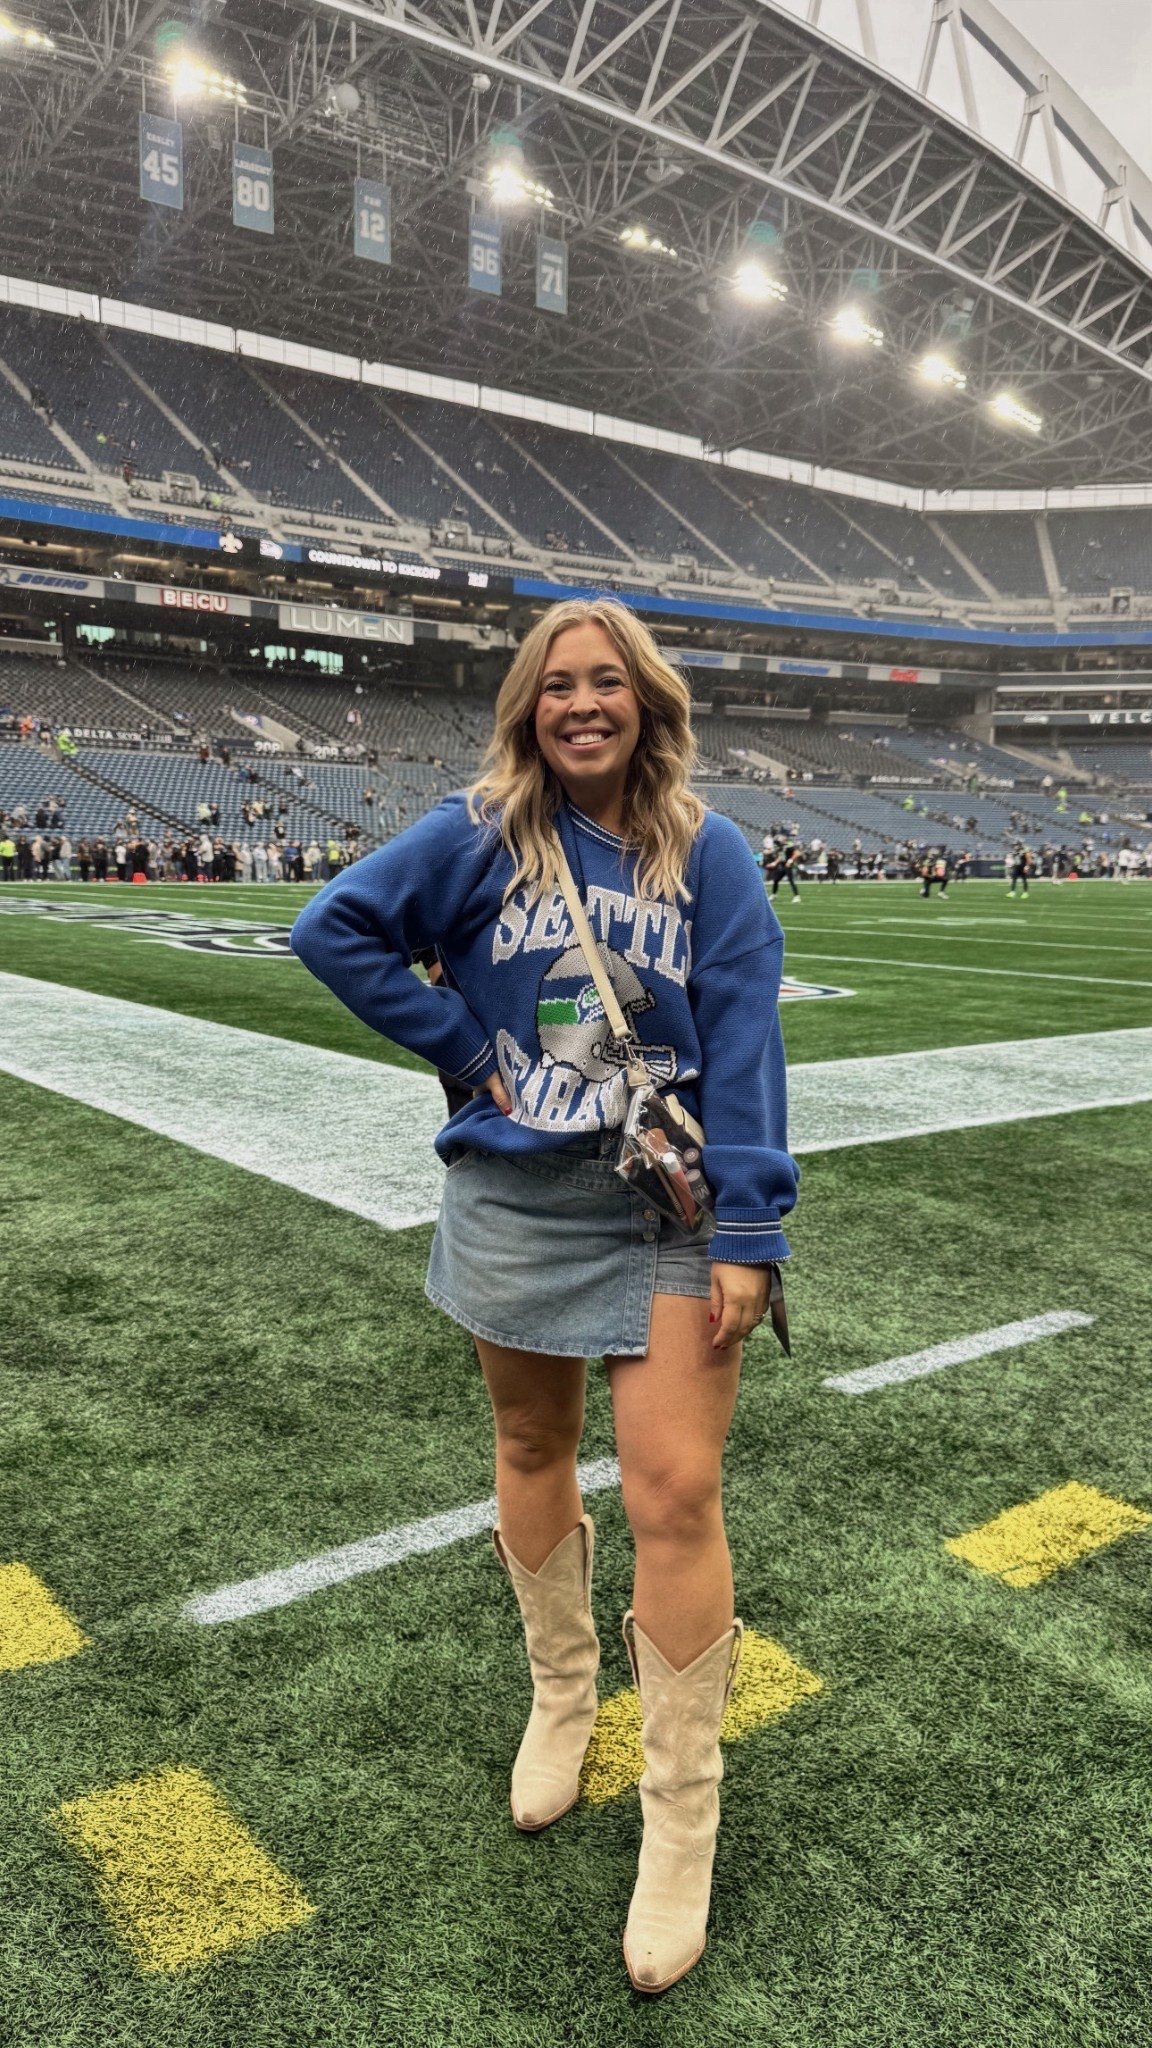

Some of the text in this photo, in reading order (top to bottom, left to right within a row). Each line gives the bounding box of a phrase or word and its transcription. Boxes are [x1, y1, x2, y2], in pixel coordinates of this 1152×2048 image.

[142, 149, 179, 187] 45
[236, 175, 270, 212] 80
[360, 208, 386, 244] 12
[473, 243, 499, 276] 96
[540, 264, 563, 296] 71
[16, 572, 89, 591] BOEING
[308, 549, 441, 580] COUNTDOWN TO KICKOFF
[290, 606, 405, 642] LUMEN
[73, 727, 113, 740] DELTA
[492, 876, 693, 987] SETTL
